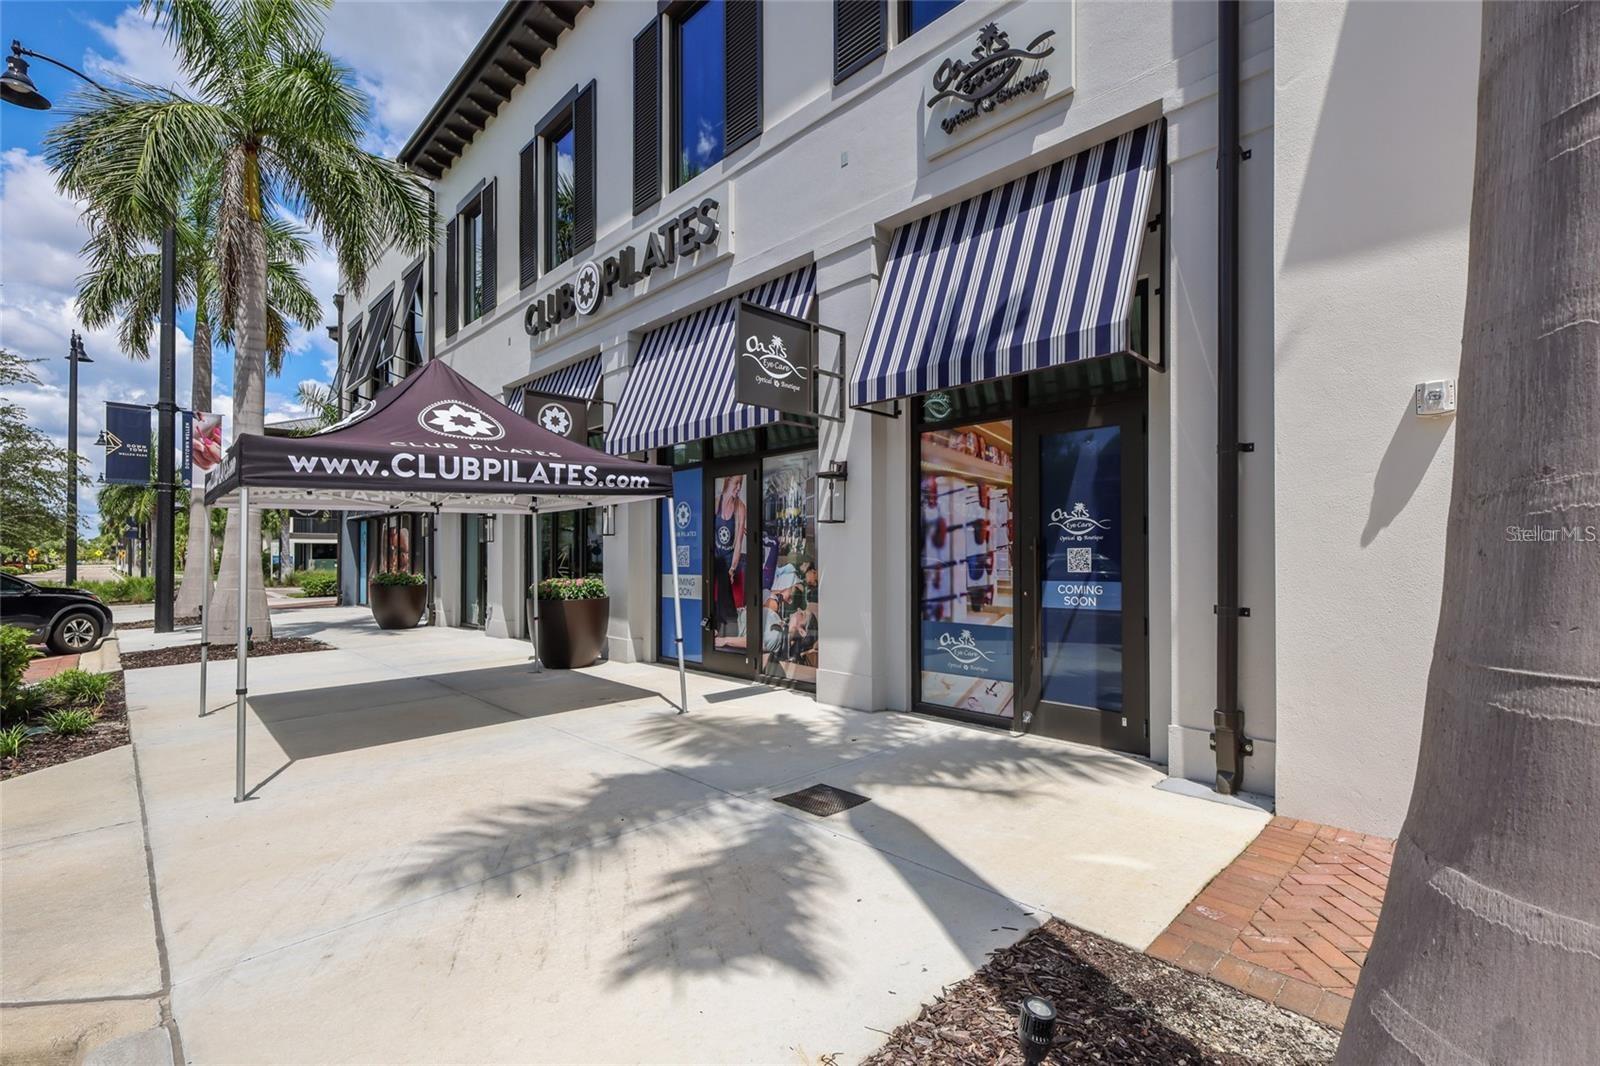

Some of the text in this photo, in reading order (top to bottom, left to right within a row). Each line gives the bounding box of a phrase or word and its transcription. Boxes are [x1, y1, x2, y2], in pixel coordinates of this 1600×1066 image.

[524, 198, 720, 336] CLUB PILATES
[746, 335, 787, 359] Oasis
[389, 441, 562, 458] CLUB PILATES
[287, 453, 650, 488] www.CLUBPILATES.com
[1051, 502, 1090, 522] Oasis
[1057, 584, 1104, 596] COMING
[1063, 596, 1097, 607] SOON
[940, 629, 976, 646] Oasis
